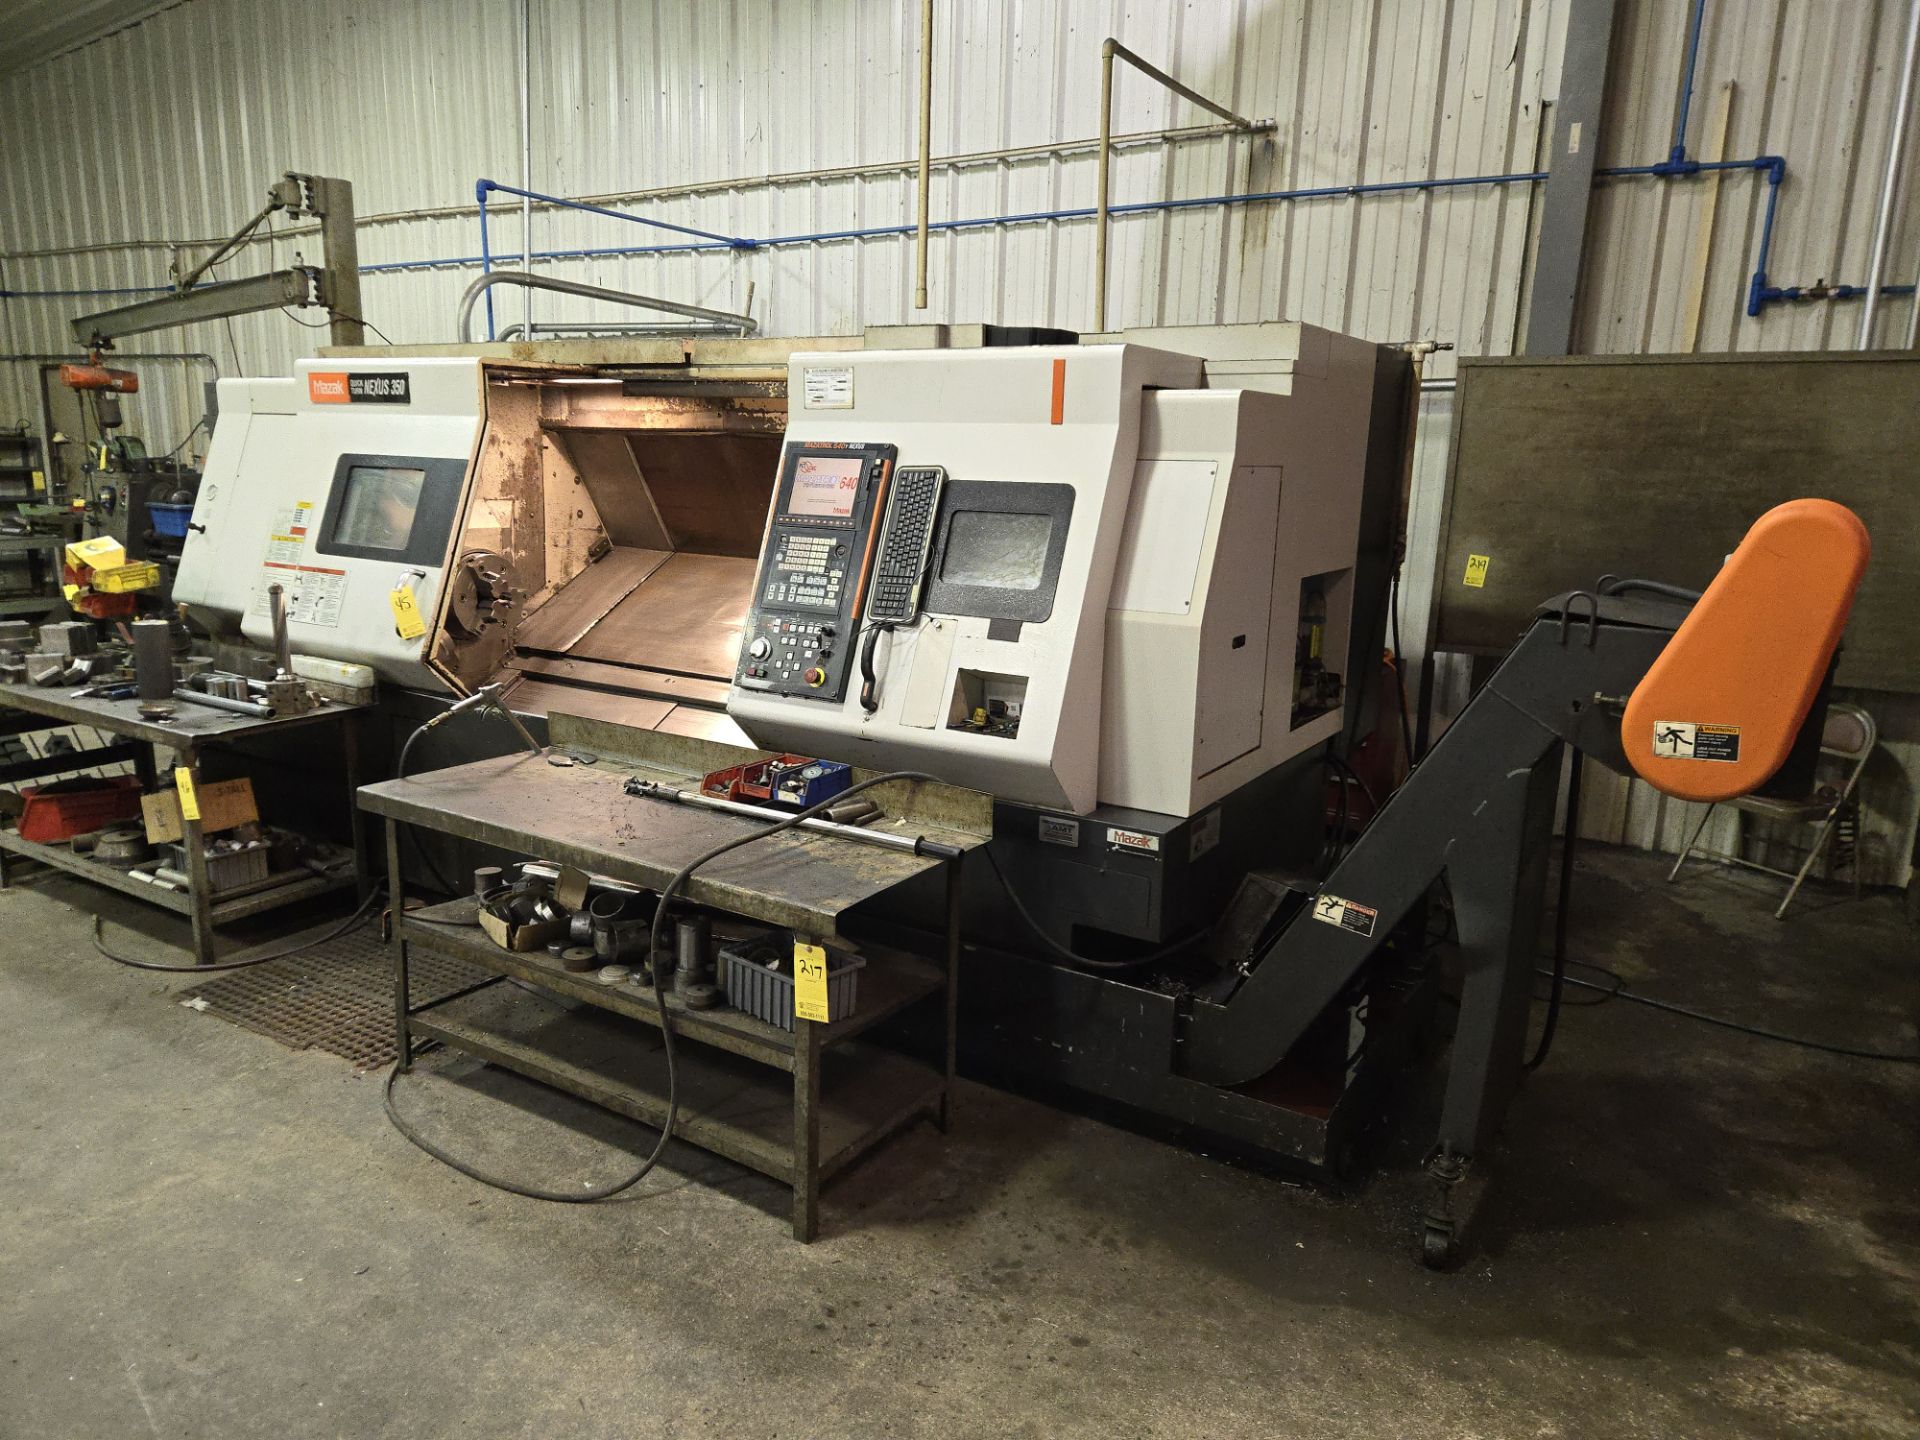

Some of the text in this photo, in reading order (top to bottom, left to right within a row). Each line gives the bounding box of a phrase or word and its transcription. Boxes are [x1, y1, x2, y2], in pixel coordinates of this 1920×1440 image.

[313, 379, 345, 395] Mazak
[364, 378, 406, 396] NEXUS 350
[839, 476, 858, 490] 640
[395, 596, 411, 610] 45
[1704, 726, 1738, 734] WARNING
[1113, 830, 1151, 848] Mazak
[799, 959, 822, 980] 217
